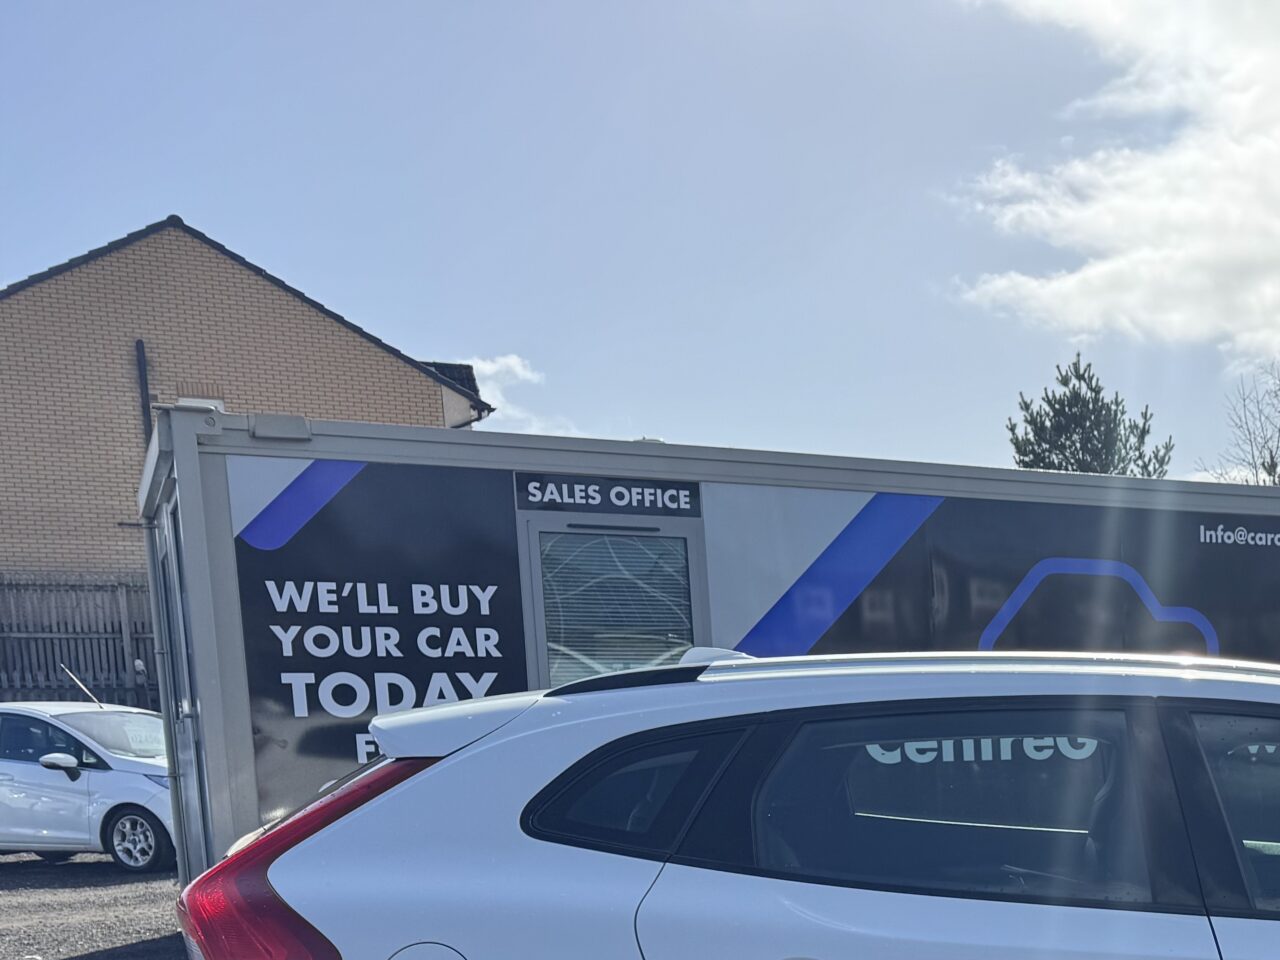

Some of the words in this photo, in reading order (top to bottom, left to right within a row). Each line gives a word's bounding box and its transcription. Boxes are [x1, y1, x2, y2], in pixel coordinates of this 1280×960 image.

[527, 481, 602, 505] SALES
[609, 486, 691, 509] OFFICE
[264, 580, 399, 614] WE'LL
[411, 583, 498, 616] BUY
[268, 624, 404, 658] YOUR
[416, 626, 503, 658] CAR
[280, 671, 498, 718] TODAY
